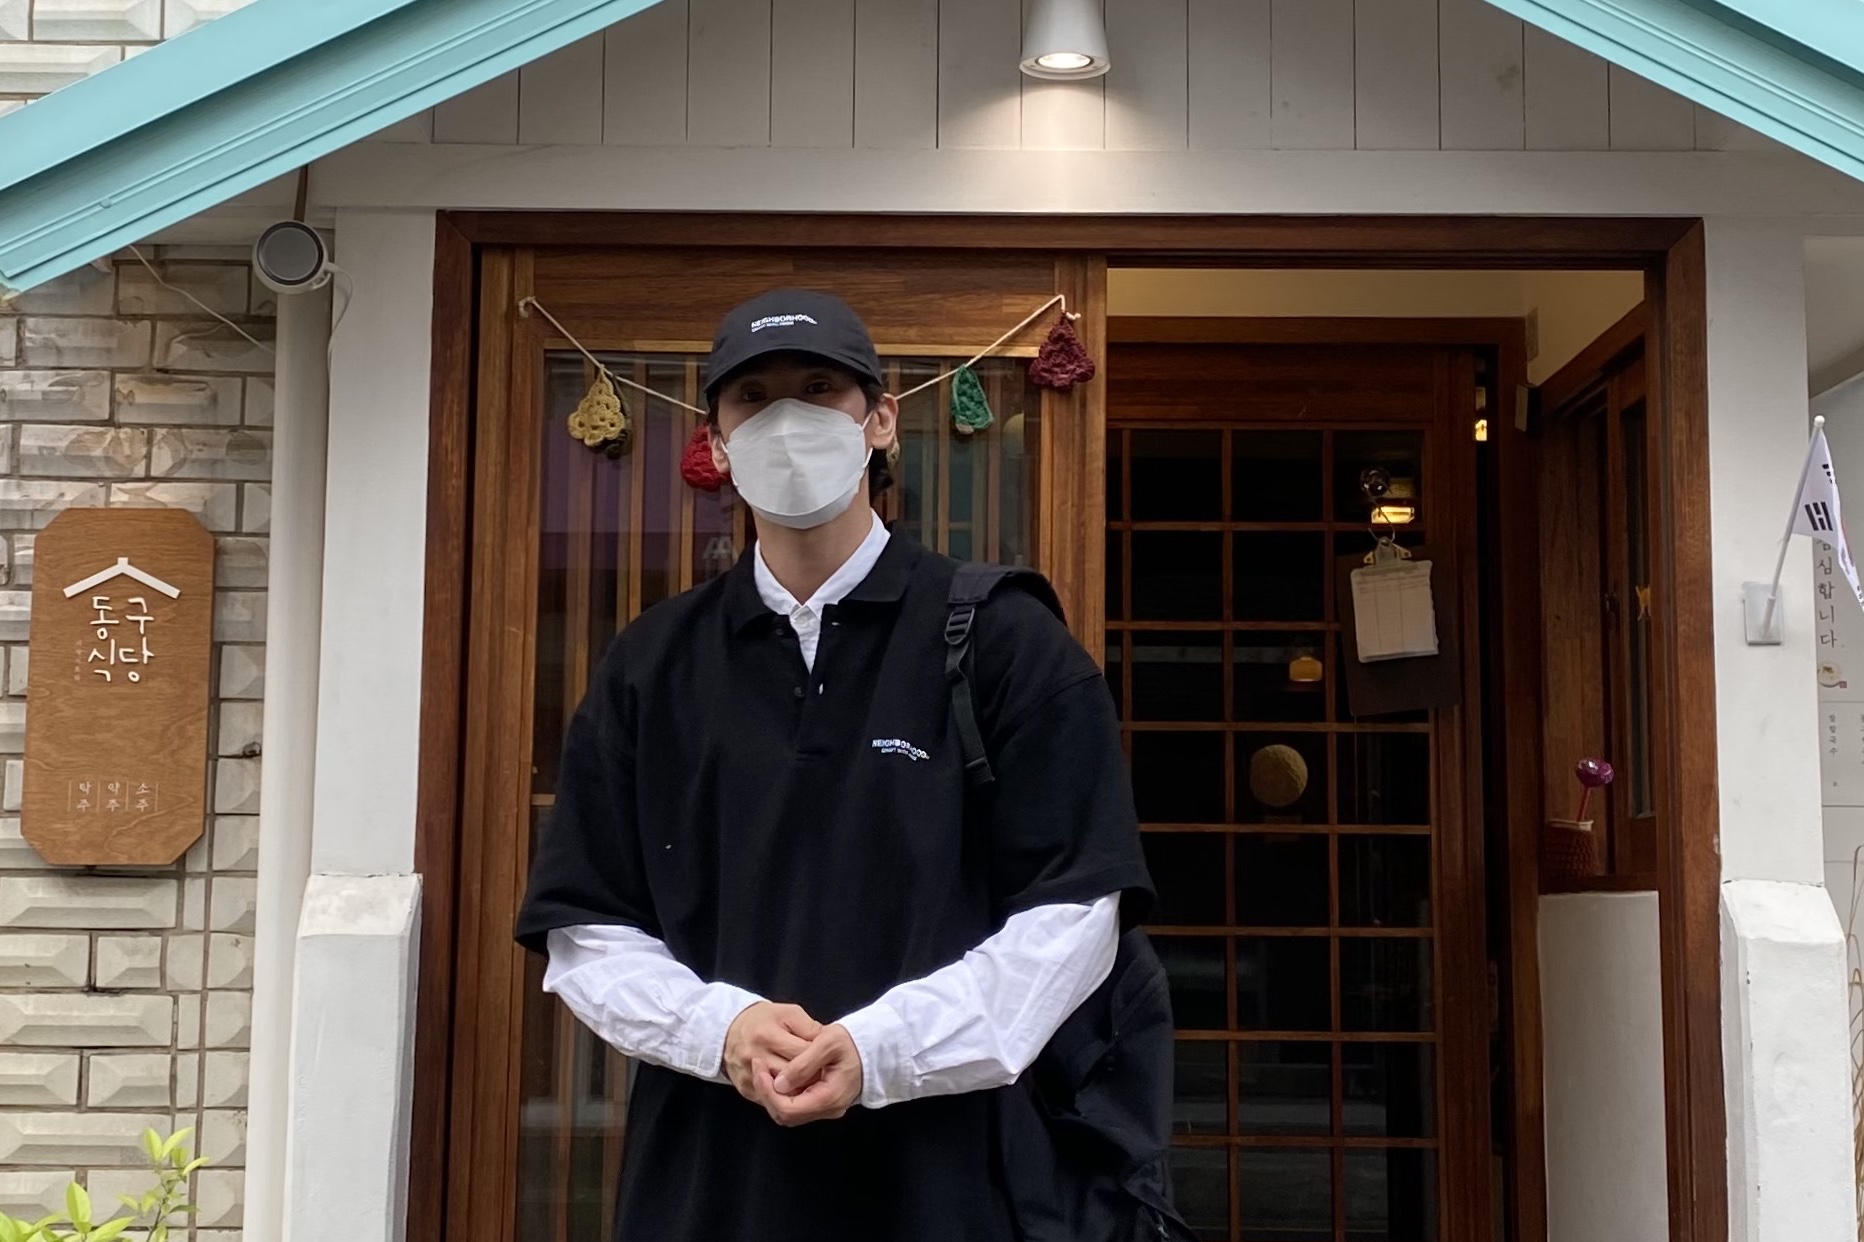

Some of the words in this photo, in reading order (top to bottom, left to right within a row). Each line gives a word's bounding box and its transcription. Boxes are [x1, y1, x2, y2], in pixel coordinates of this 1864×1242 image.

[90, 596, 155, 640] 동구
[88, 636, 155, 683] 식당
[871, 739, 930, 760] NEIGHBOROOD
[135, 781, 151, 813] 소주
